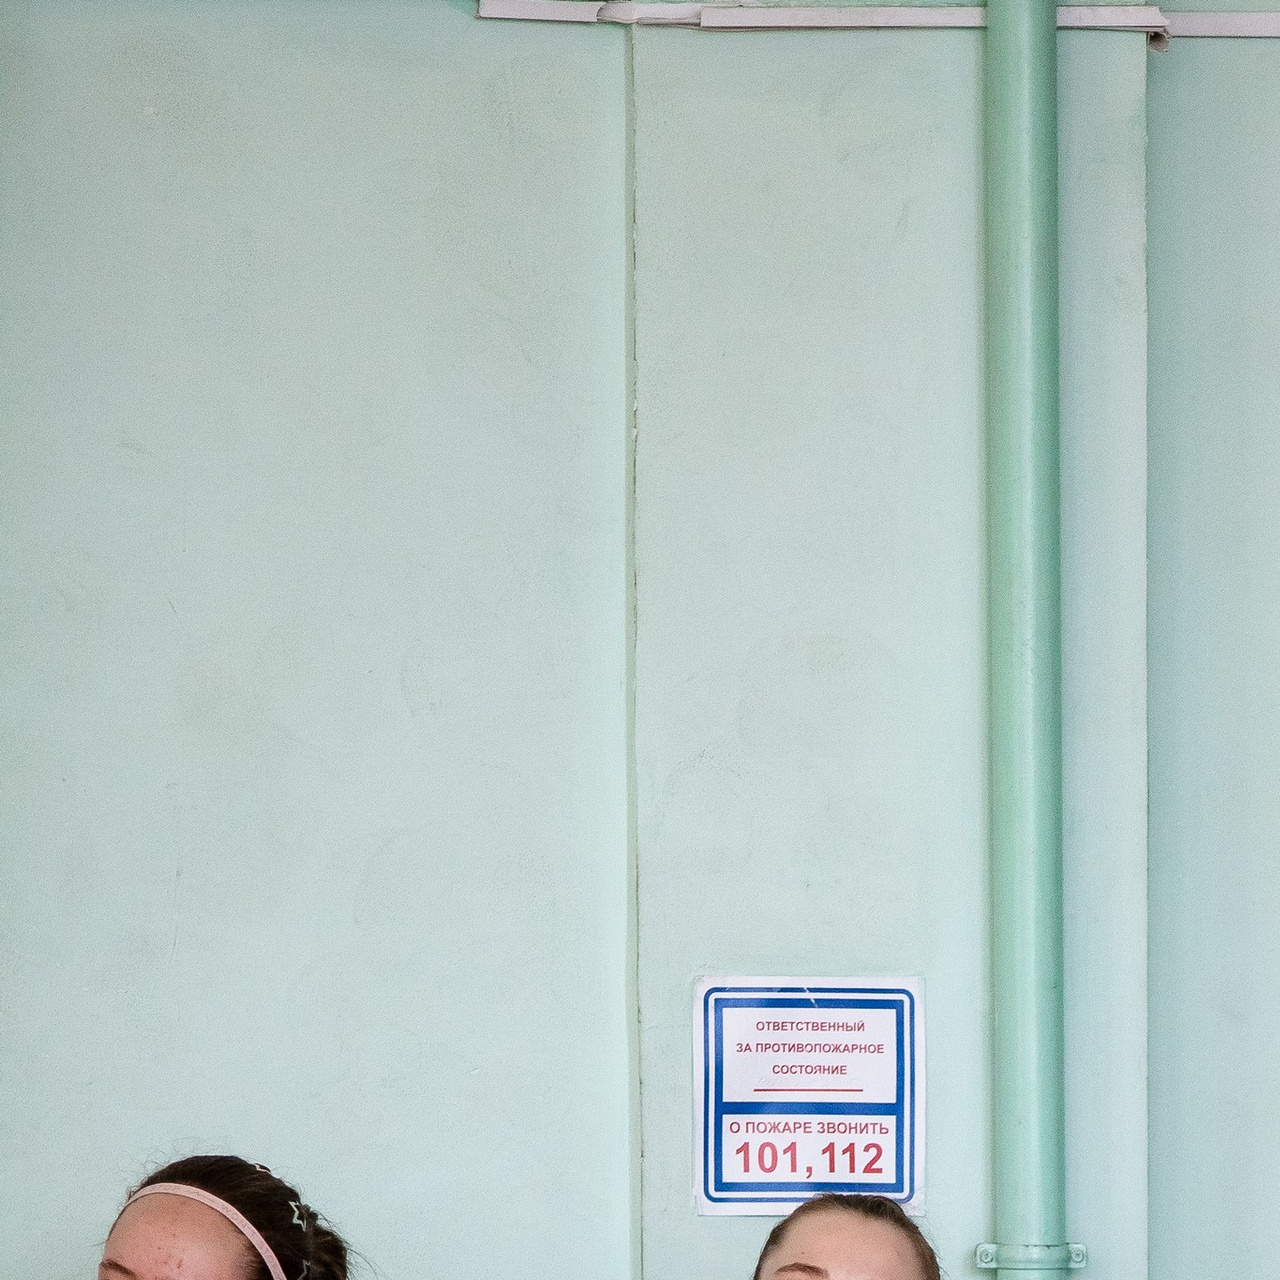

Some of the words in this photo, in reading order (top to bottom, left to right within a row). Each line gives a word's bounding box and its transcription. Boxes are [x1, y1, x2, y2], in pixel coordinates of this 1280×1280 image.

[756, 1020, 866, 1032] ОТВЕТСТВЕННЫЙ
[736, 1043, 753, 1053] ЗА
[755, 1043, 885, 1054] ПРОТИВОПОЖАРНОЕ
[772, 1064, 848, 1075] СОСТОЯНИЕ
[729, 1121, 741, 1134] О
[745, 1121, 813, 1134] ПОЖАРЕ
[817, 1122, 889, 1135] ЗВОНИТЬ
